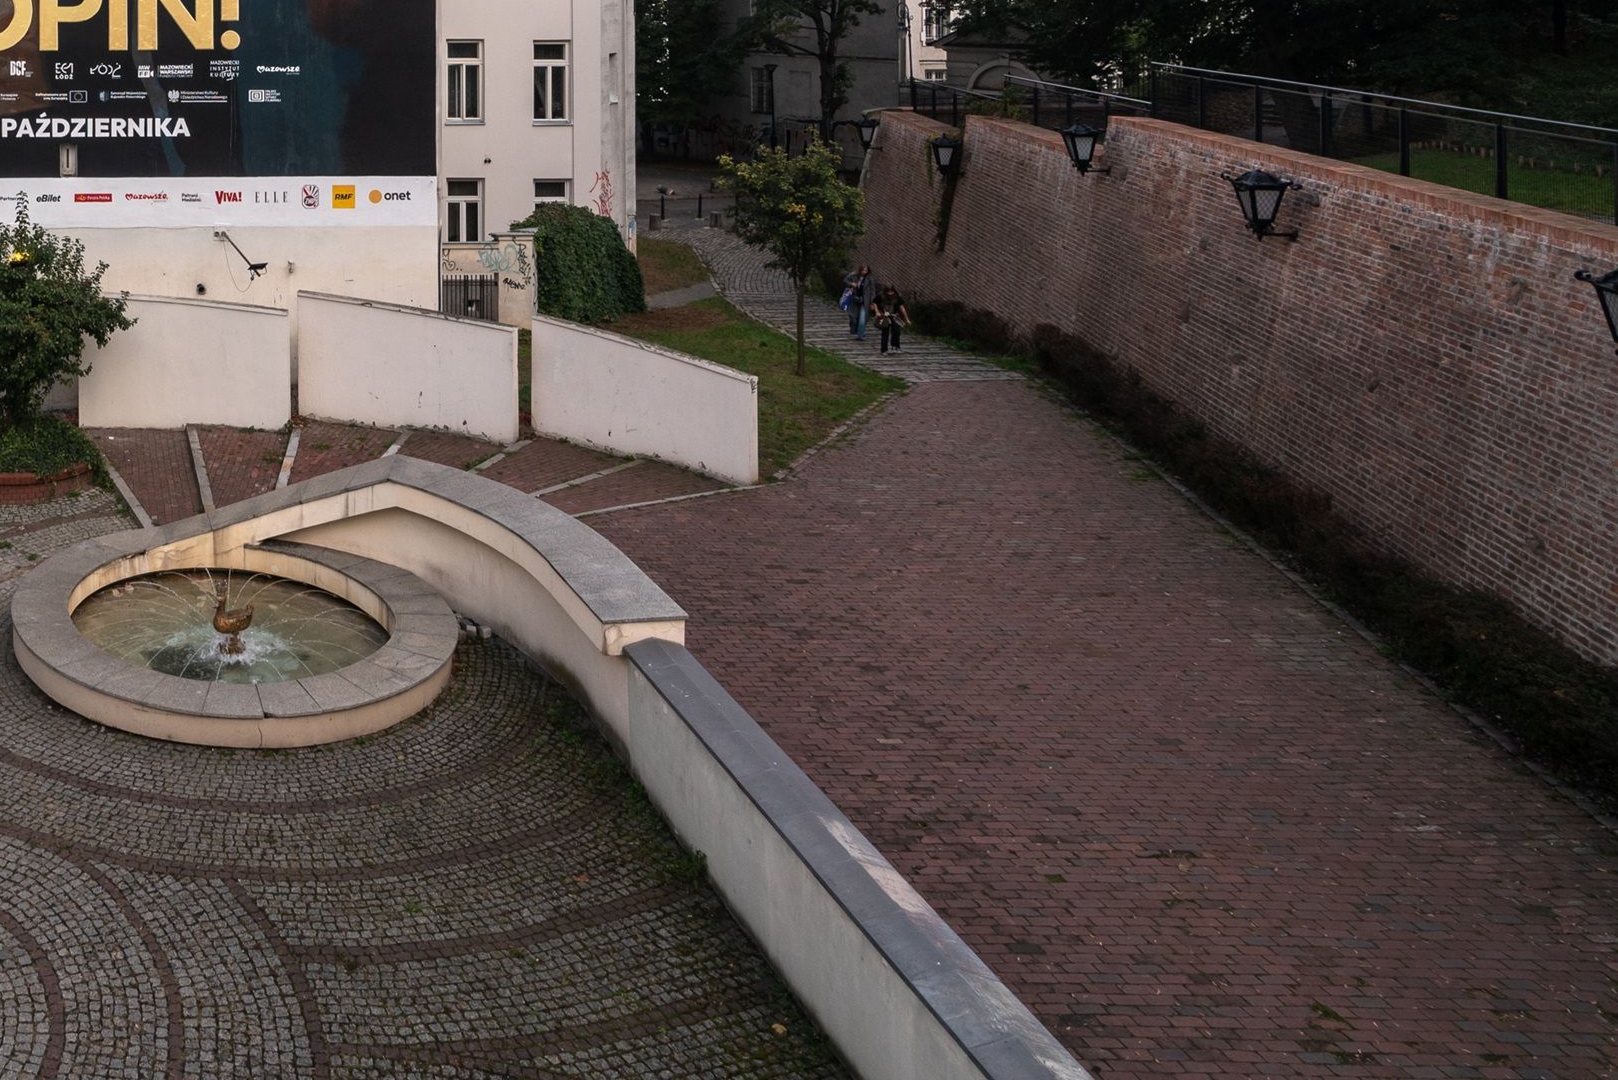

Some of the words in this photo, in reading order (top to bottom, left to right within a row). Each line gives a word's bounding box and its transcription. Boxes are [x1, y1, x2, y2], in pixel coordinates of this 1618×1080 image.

[2, 112, 191, 138] PAŹDZIERNIKA
[36, 194, 62, 203] eBilet
[215, 190, 242, 204] VIVA!
[255, 191, 288, 203] ELLE
[334, 193, 353, 201] RMF
[383, 190, 411, 201] onet
